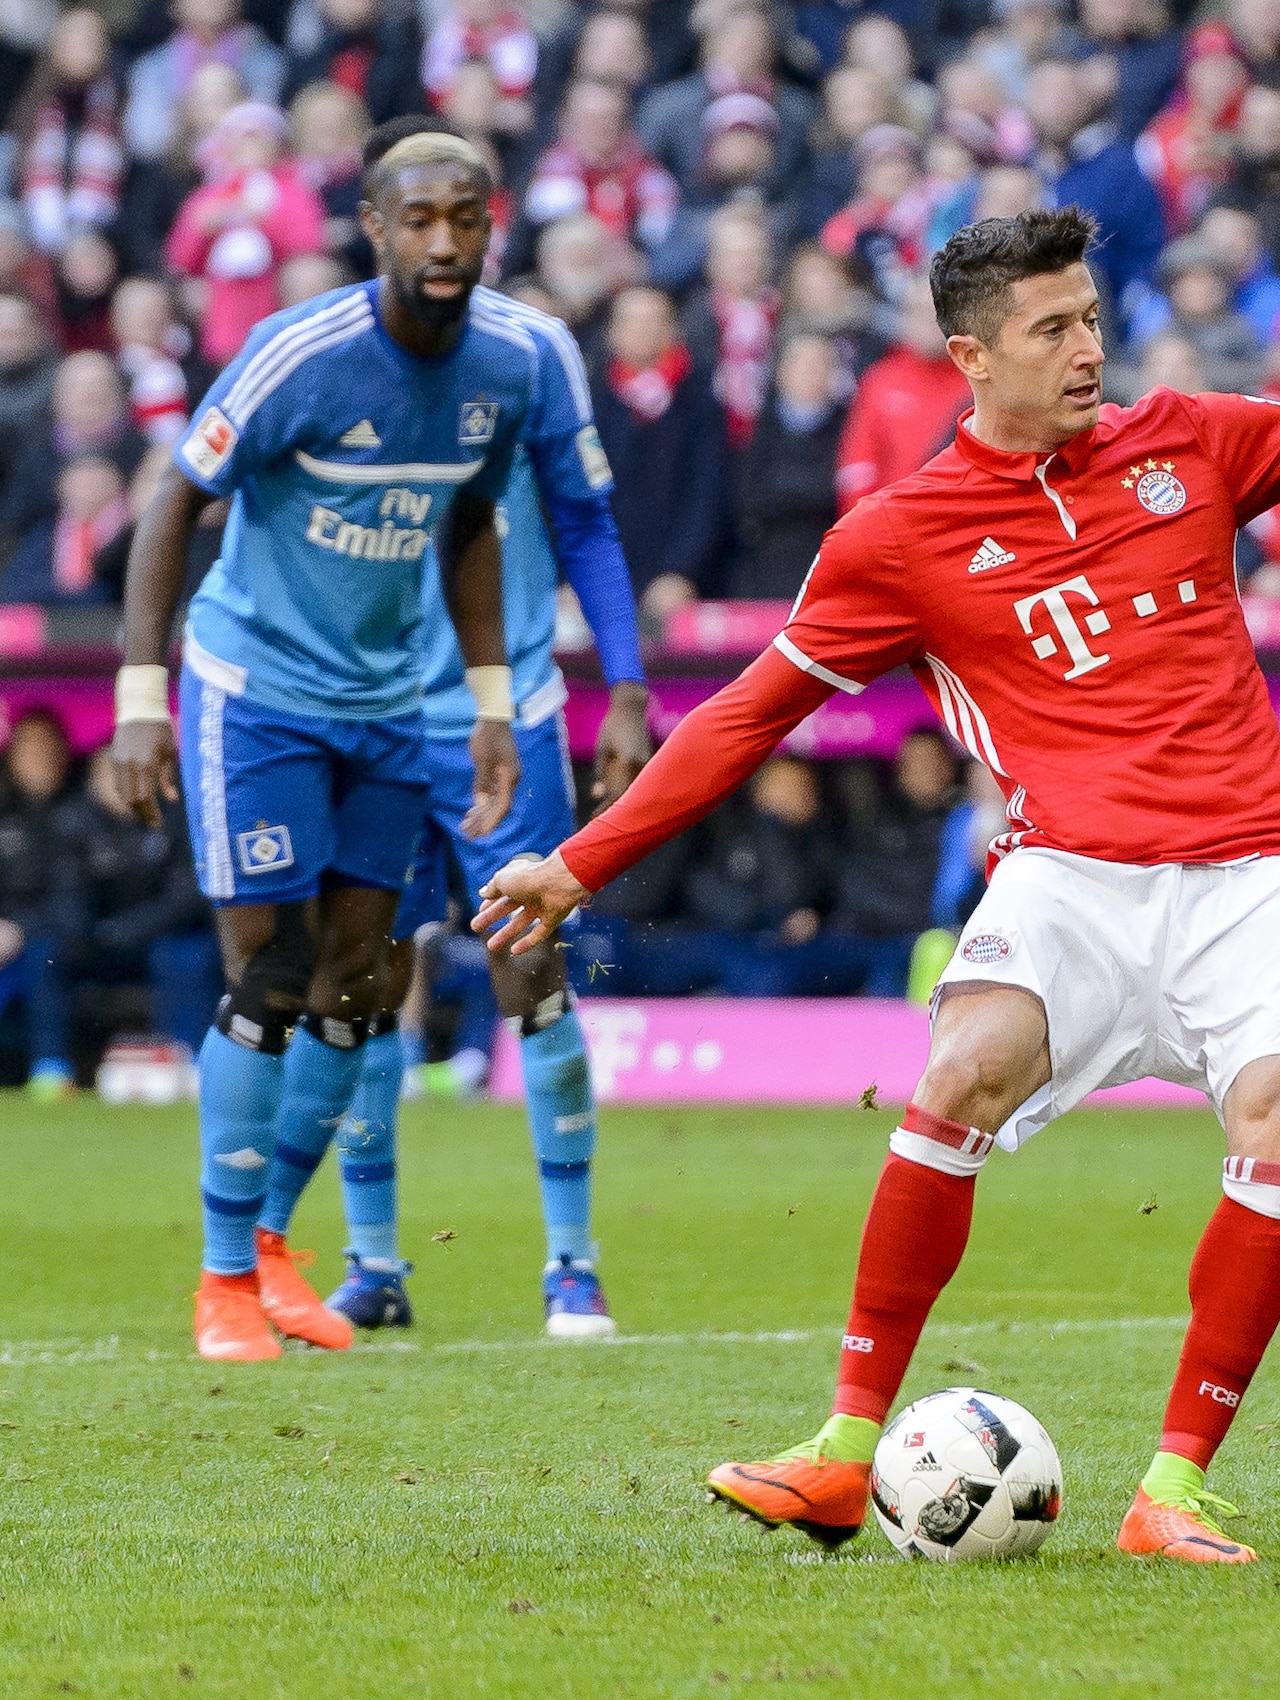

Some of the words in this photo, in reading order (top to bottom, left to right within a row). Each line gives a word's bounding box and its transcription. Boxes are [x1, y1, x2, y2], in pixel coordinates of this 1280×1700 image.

[378, 487, 433, 525] Fly
[306, 504, 433, 562] Emira
[967, 552, 1017, 575] adidas
[842, 1334, 875, 1353] FCB
[1199, 1380, 1240, 1408] FCB
[911, 1463, 943, 1472] adidas
